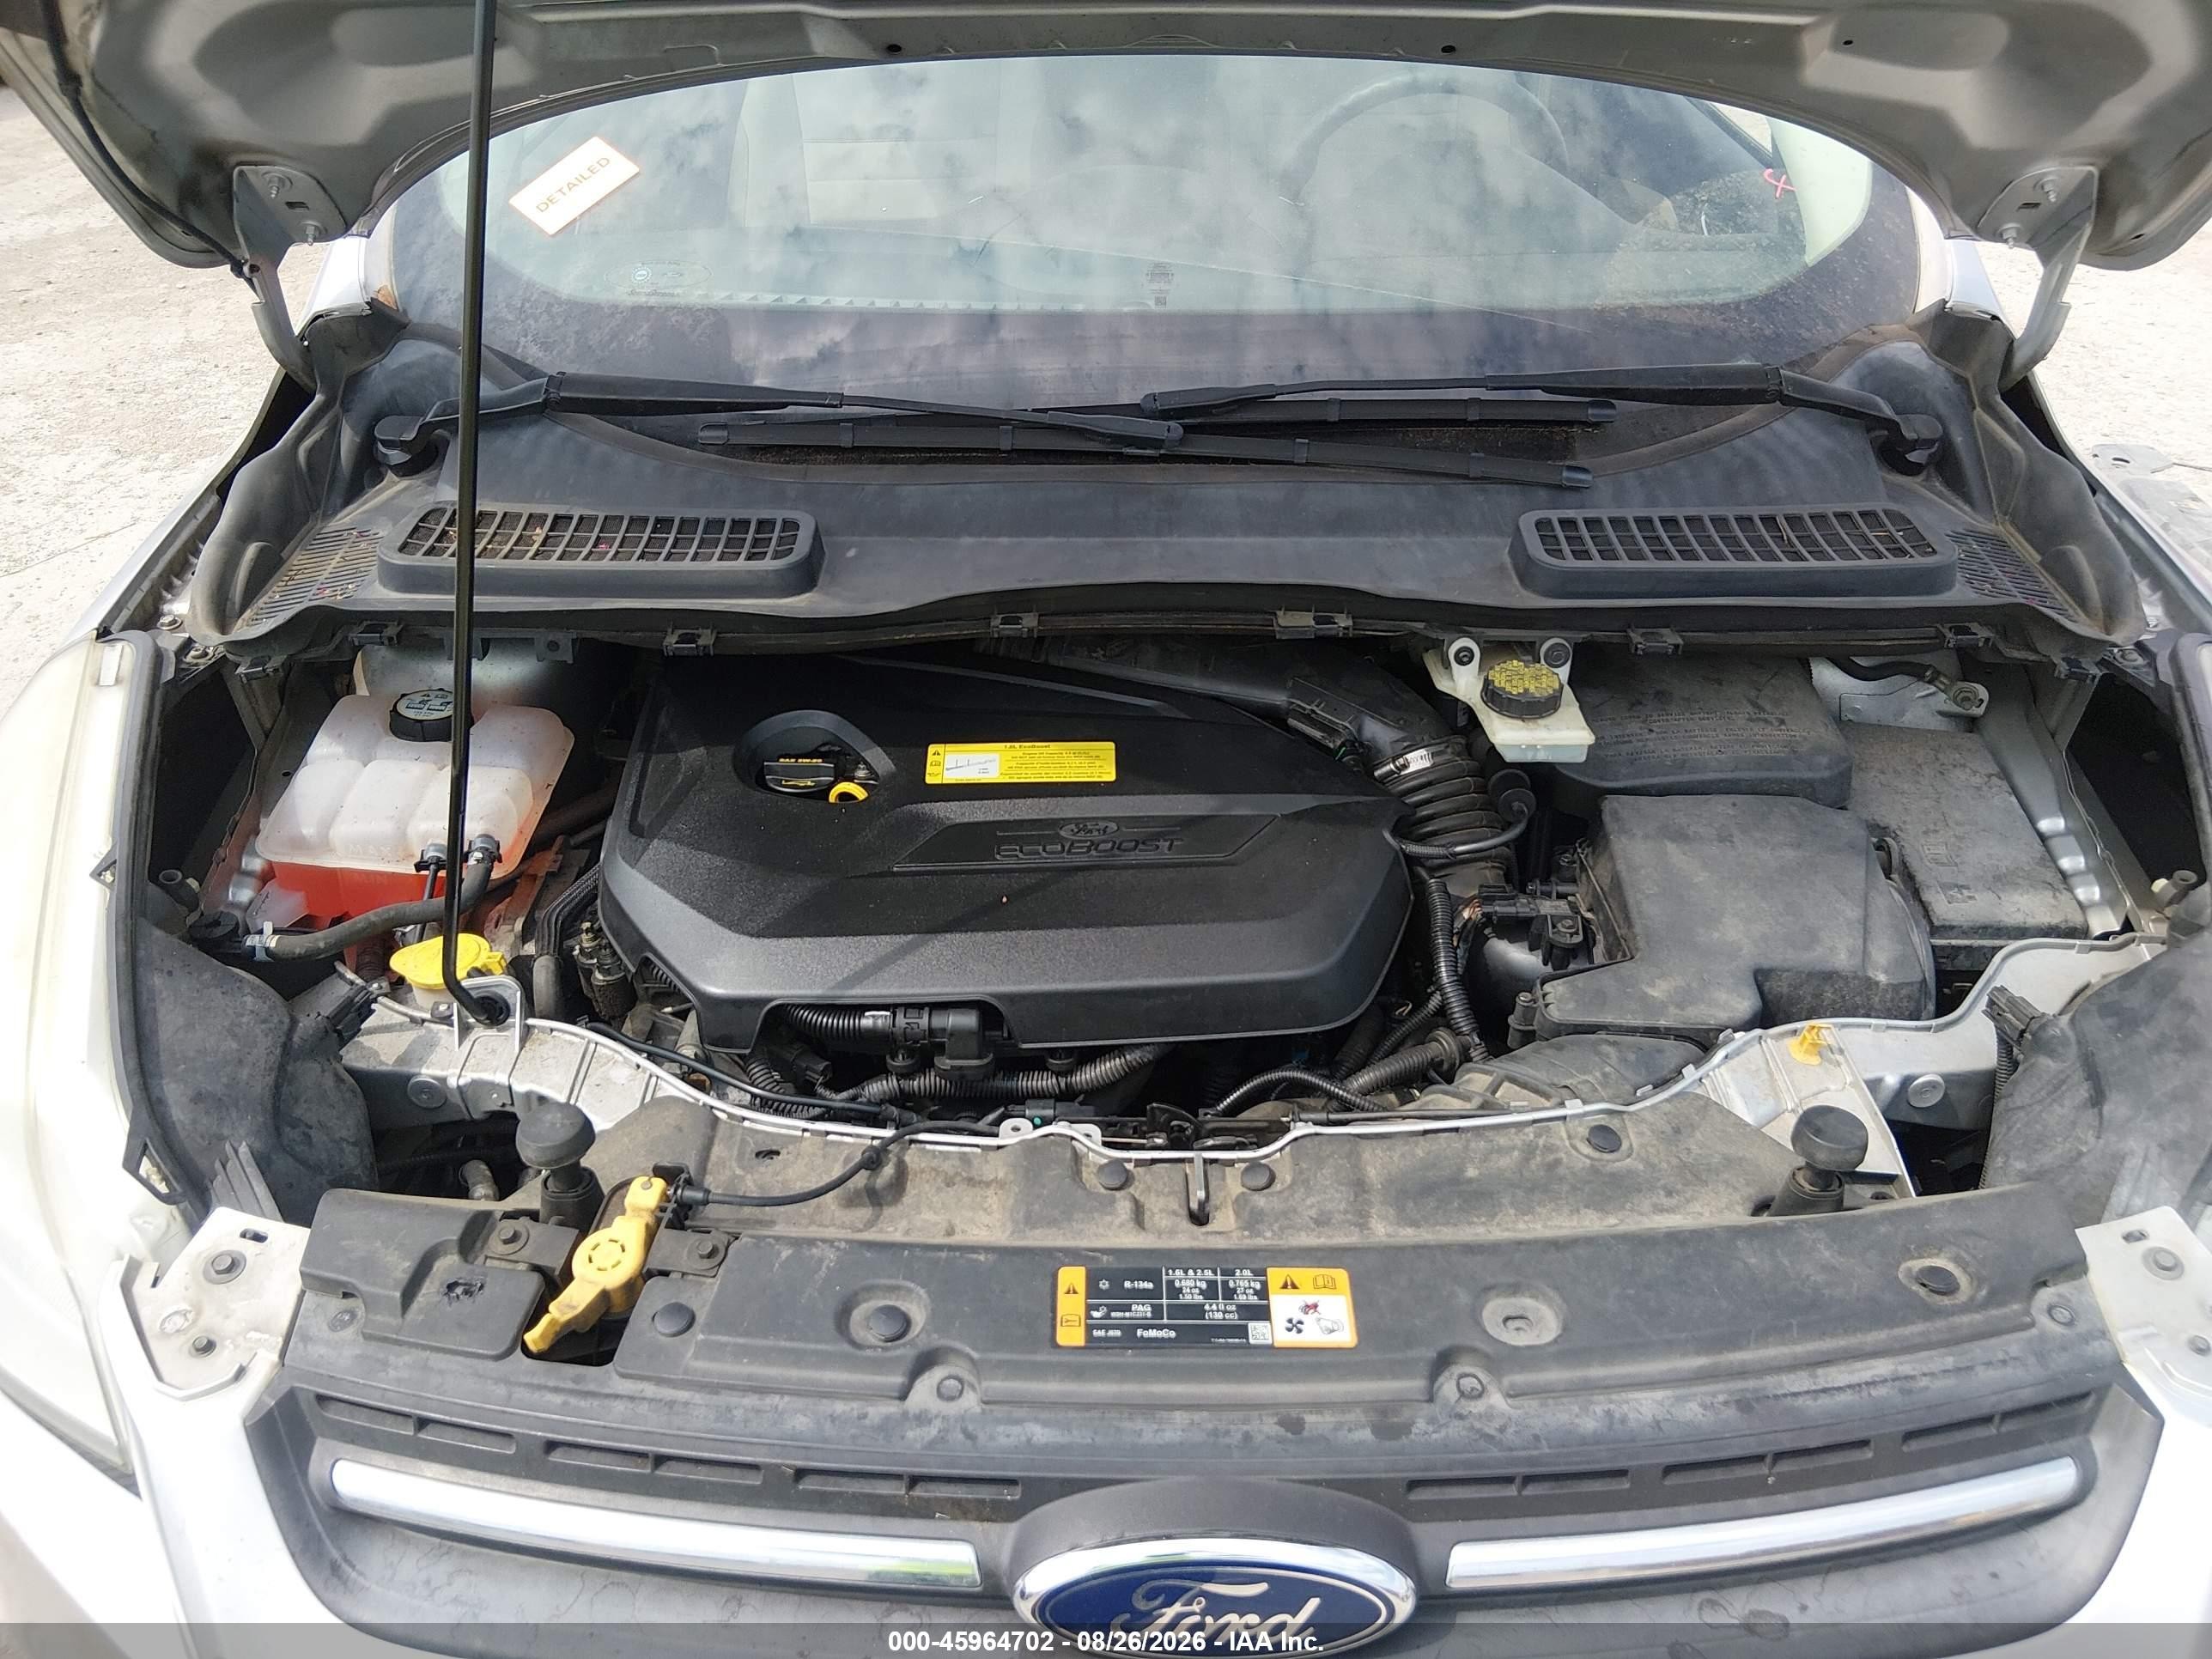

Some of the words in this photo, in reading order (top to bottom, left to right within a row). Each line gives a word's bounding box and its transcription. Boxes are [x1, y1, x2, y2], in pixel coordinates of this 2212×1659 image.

[536, 157, 611, 213] DETAILED
[1070, 822, 1109, 836] Ford
[1123, 1280, 1154, 1289] R-134a
[1196, 1279, 1207, 1290] kg
[1229, 1279, 1249, 1288] 0.765
[1250, 1279, 1261, 1290] kg
[1205, 1311, 1223, 1320] (130
[1092, 1328, 1106, 1337] SAE
[1136, 1328, 1176, 1338] FoMoCo
[1111, 1579, 1322, 1647] Ford
